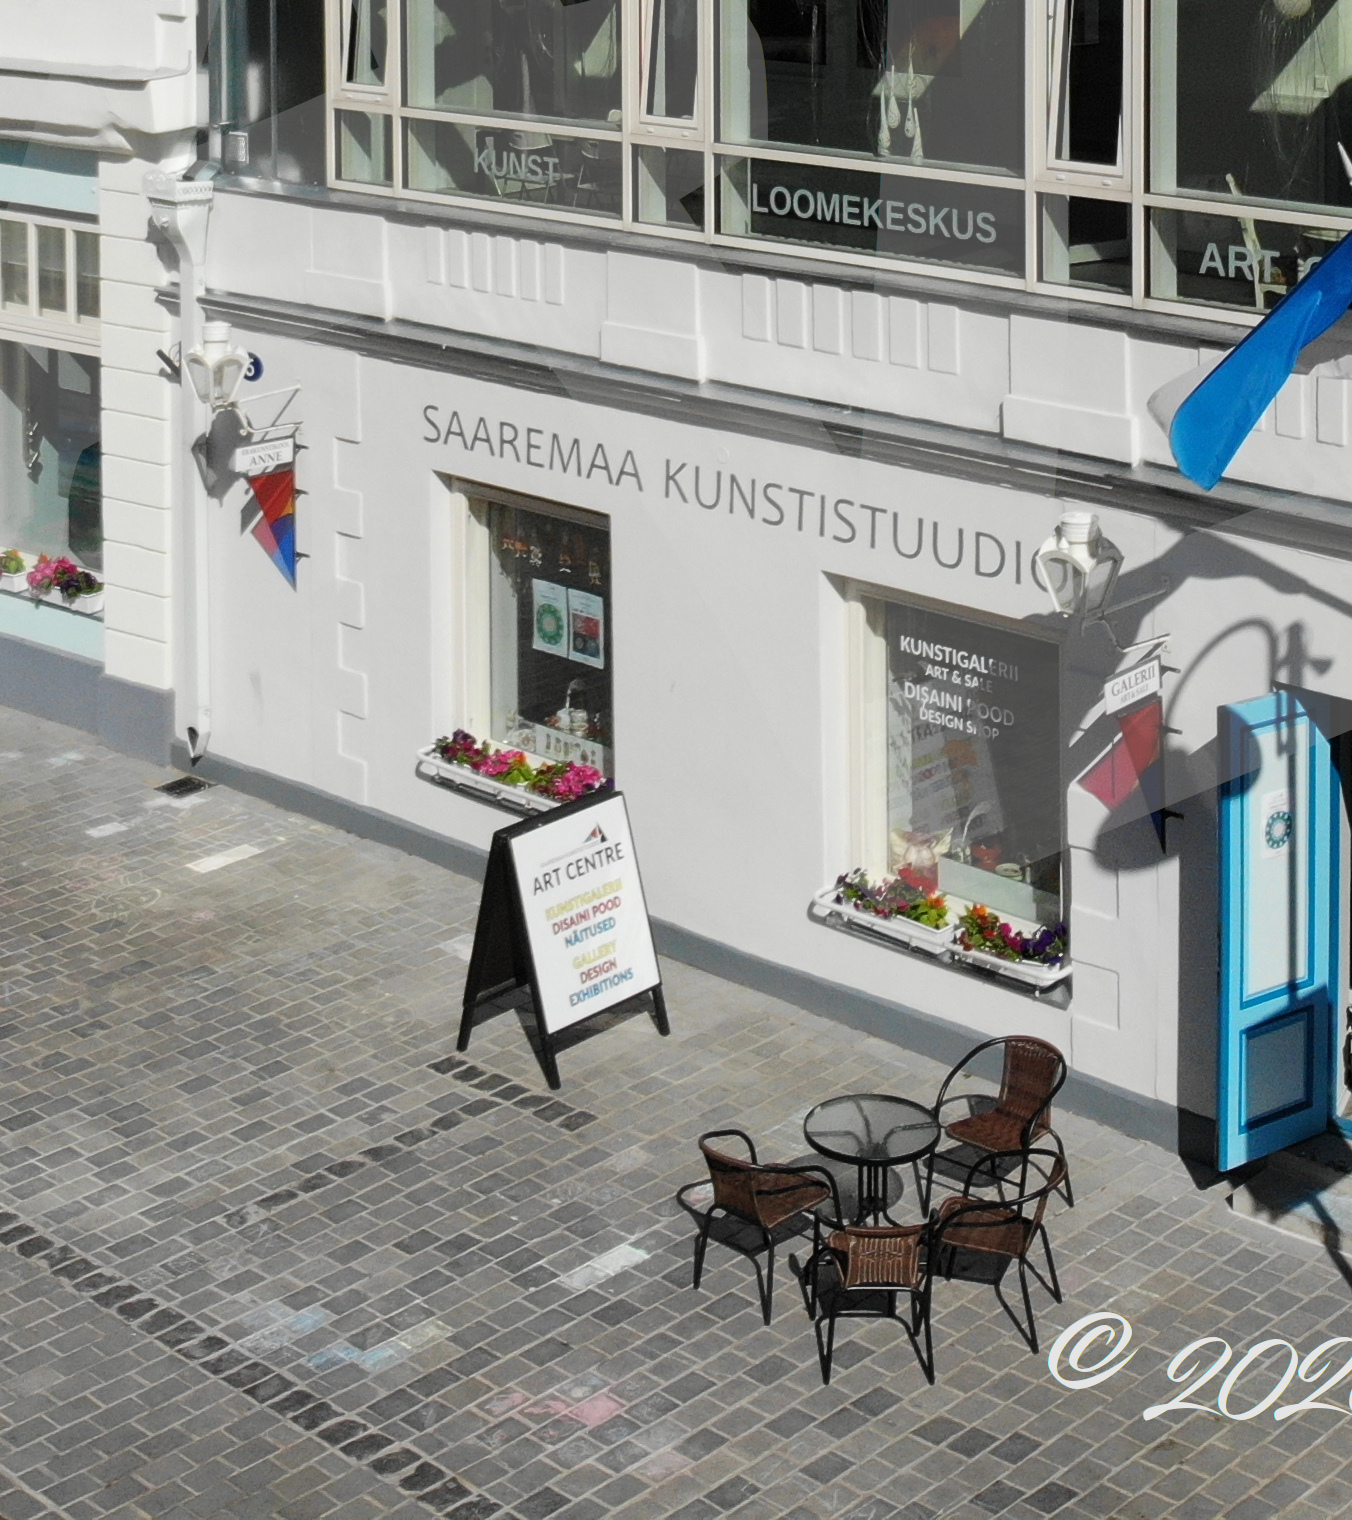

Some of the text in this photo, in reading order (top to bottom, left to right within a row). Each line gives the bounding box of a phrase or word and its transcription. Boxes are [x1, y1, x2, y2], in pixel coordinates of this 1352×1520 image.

[474, 148, 559, 186] KUNST
[752, 183, 997, 243] LOOMEKESKUS
[1199, 242, 1280, 284] ART
[249, 450, 283, 466] ANNE
[423, 404, 1068, 594] SAAREMAA KUNSTISTUUDIO
[900, 635, 1019, 682] KUNSTIGALERII
[925, 664, 993, 693] ART & SALE
[1111, 665, 1156, 697] GALERII
[904, 681, 1014, 726] DISAINI POOD
[919, 707, 964, 731] DESIGN
[533, 868, 561, 896] ART
[566, 842, 625, 880] CENTRE
[552, 896, 622, 935] DISAINI POOD
[572, 939, 618, 970] GALLERY
[580, 957, 618, 984] DESIGN
[569, 968, 635, 1007] EXHIBITIONS
